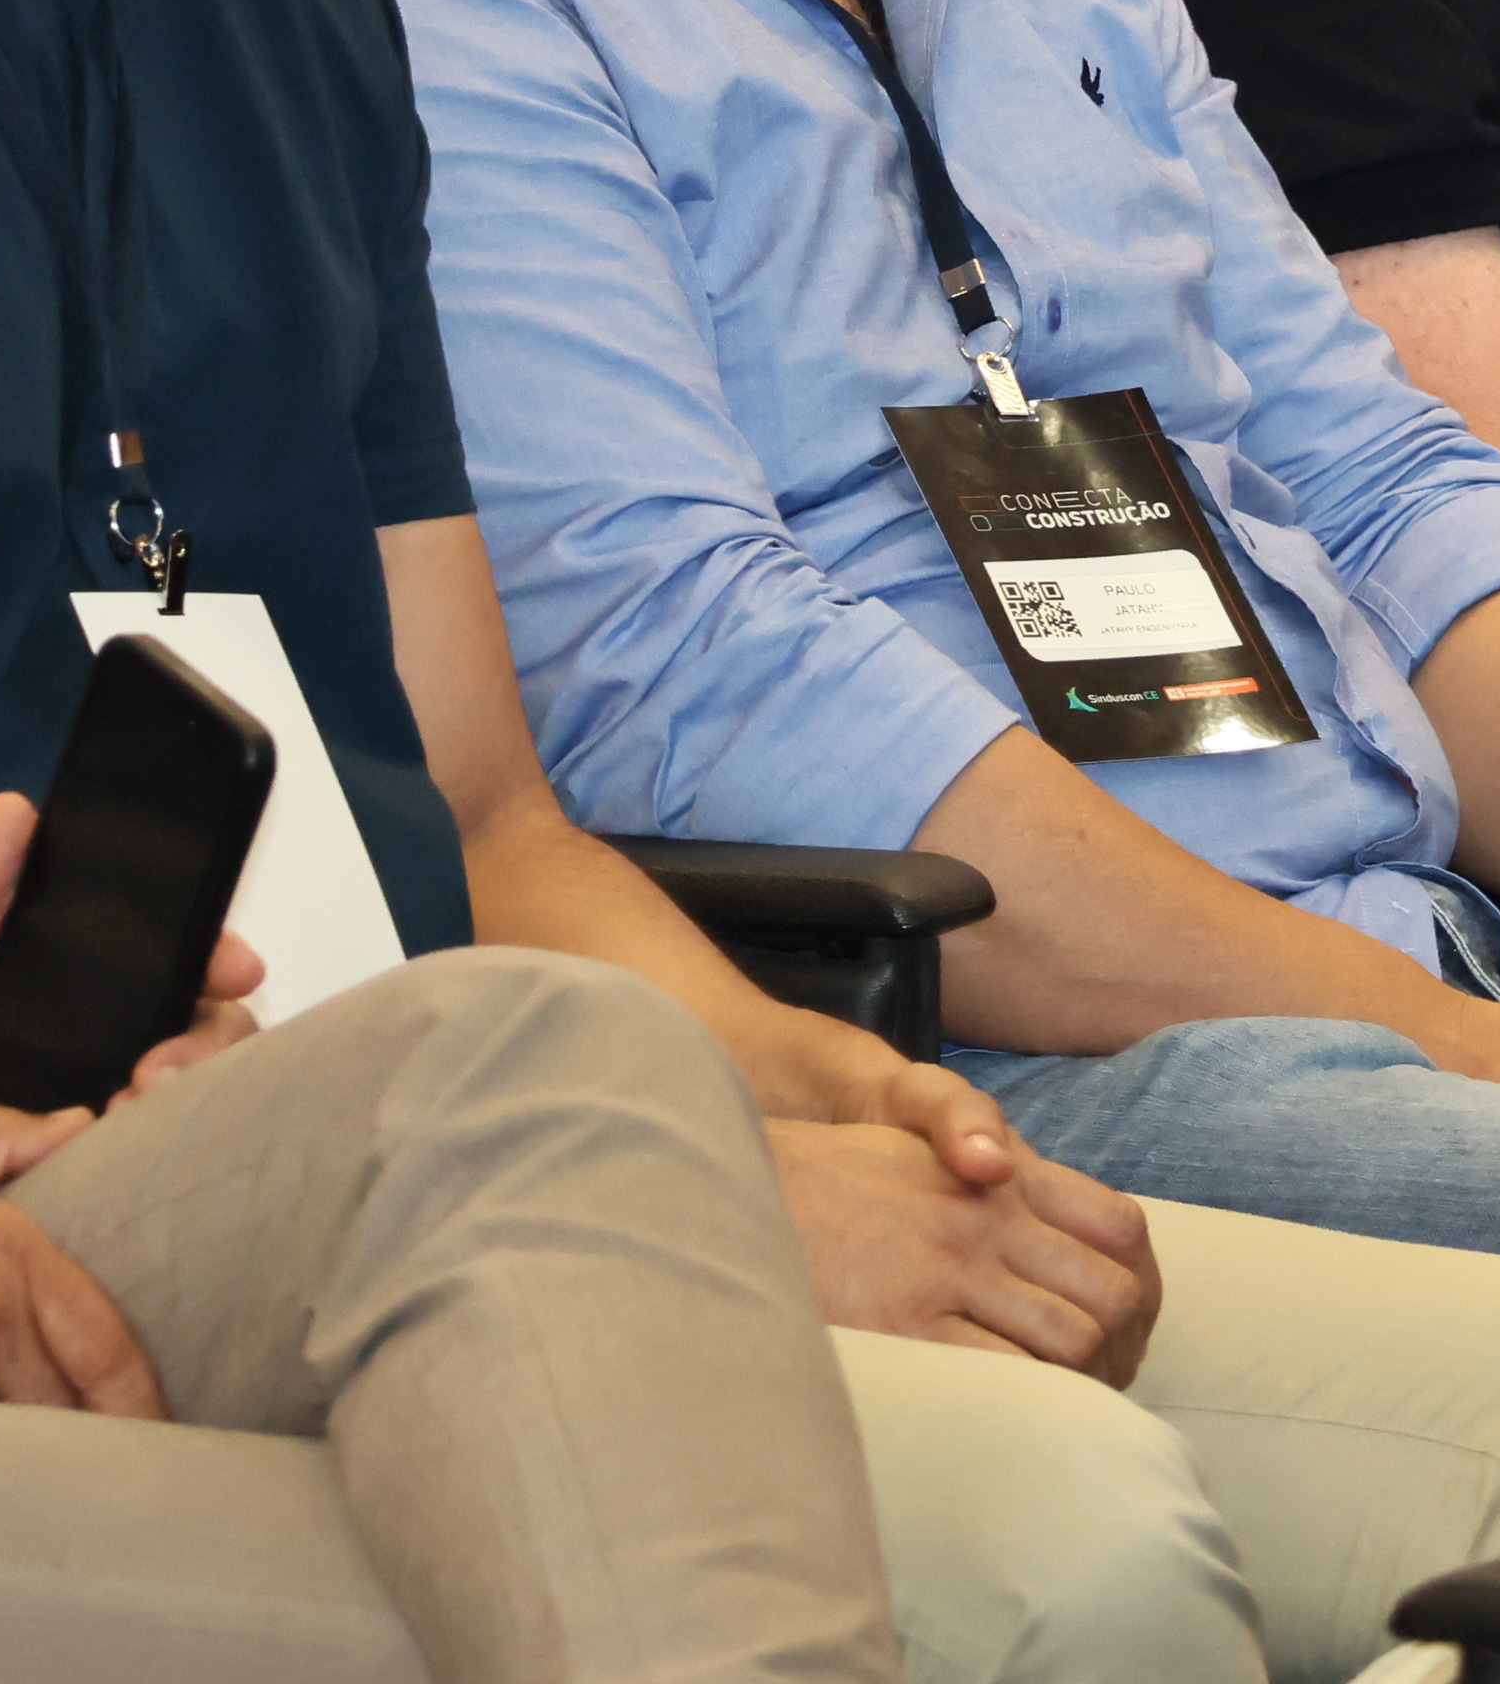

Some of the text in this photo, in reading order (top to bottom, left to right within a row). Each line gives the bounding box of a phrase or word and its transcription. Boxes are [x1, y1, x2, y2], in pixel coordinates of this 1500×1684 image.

[1000, 487, 1132, 511] CONECTA
[1025, 501, 1171, 529] CONSTRUÇÃO
[1103, 583, 1156, 596] PAULO
[1115, 603, 1163, 616] JATAHY
[1087, 690, 1160, 704] Sinduscon CE
